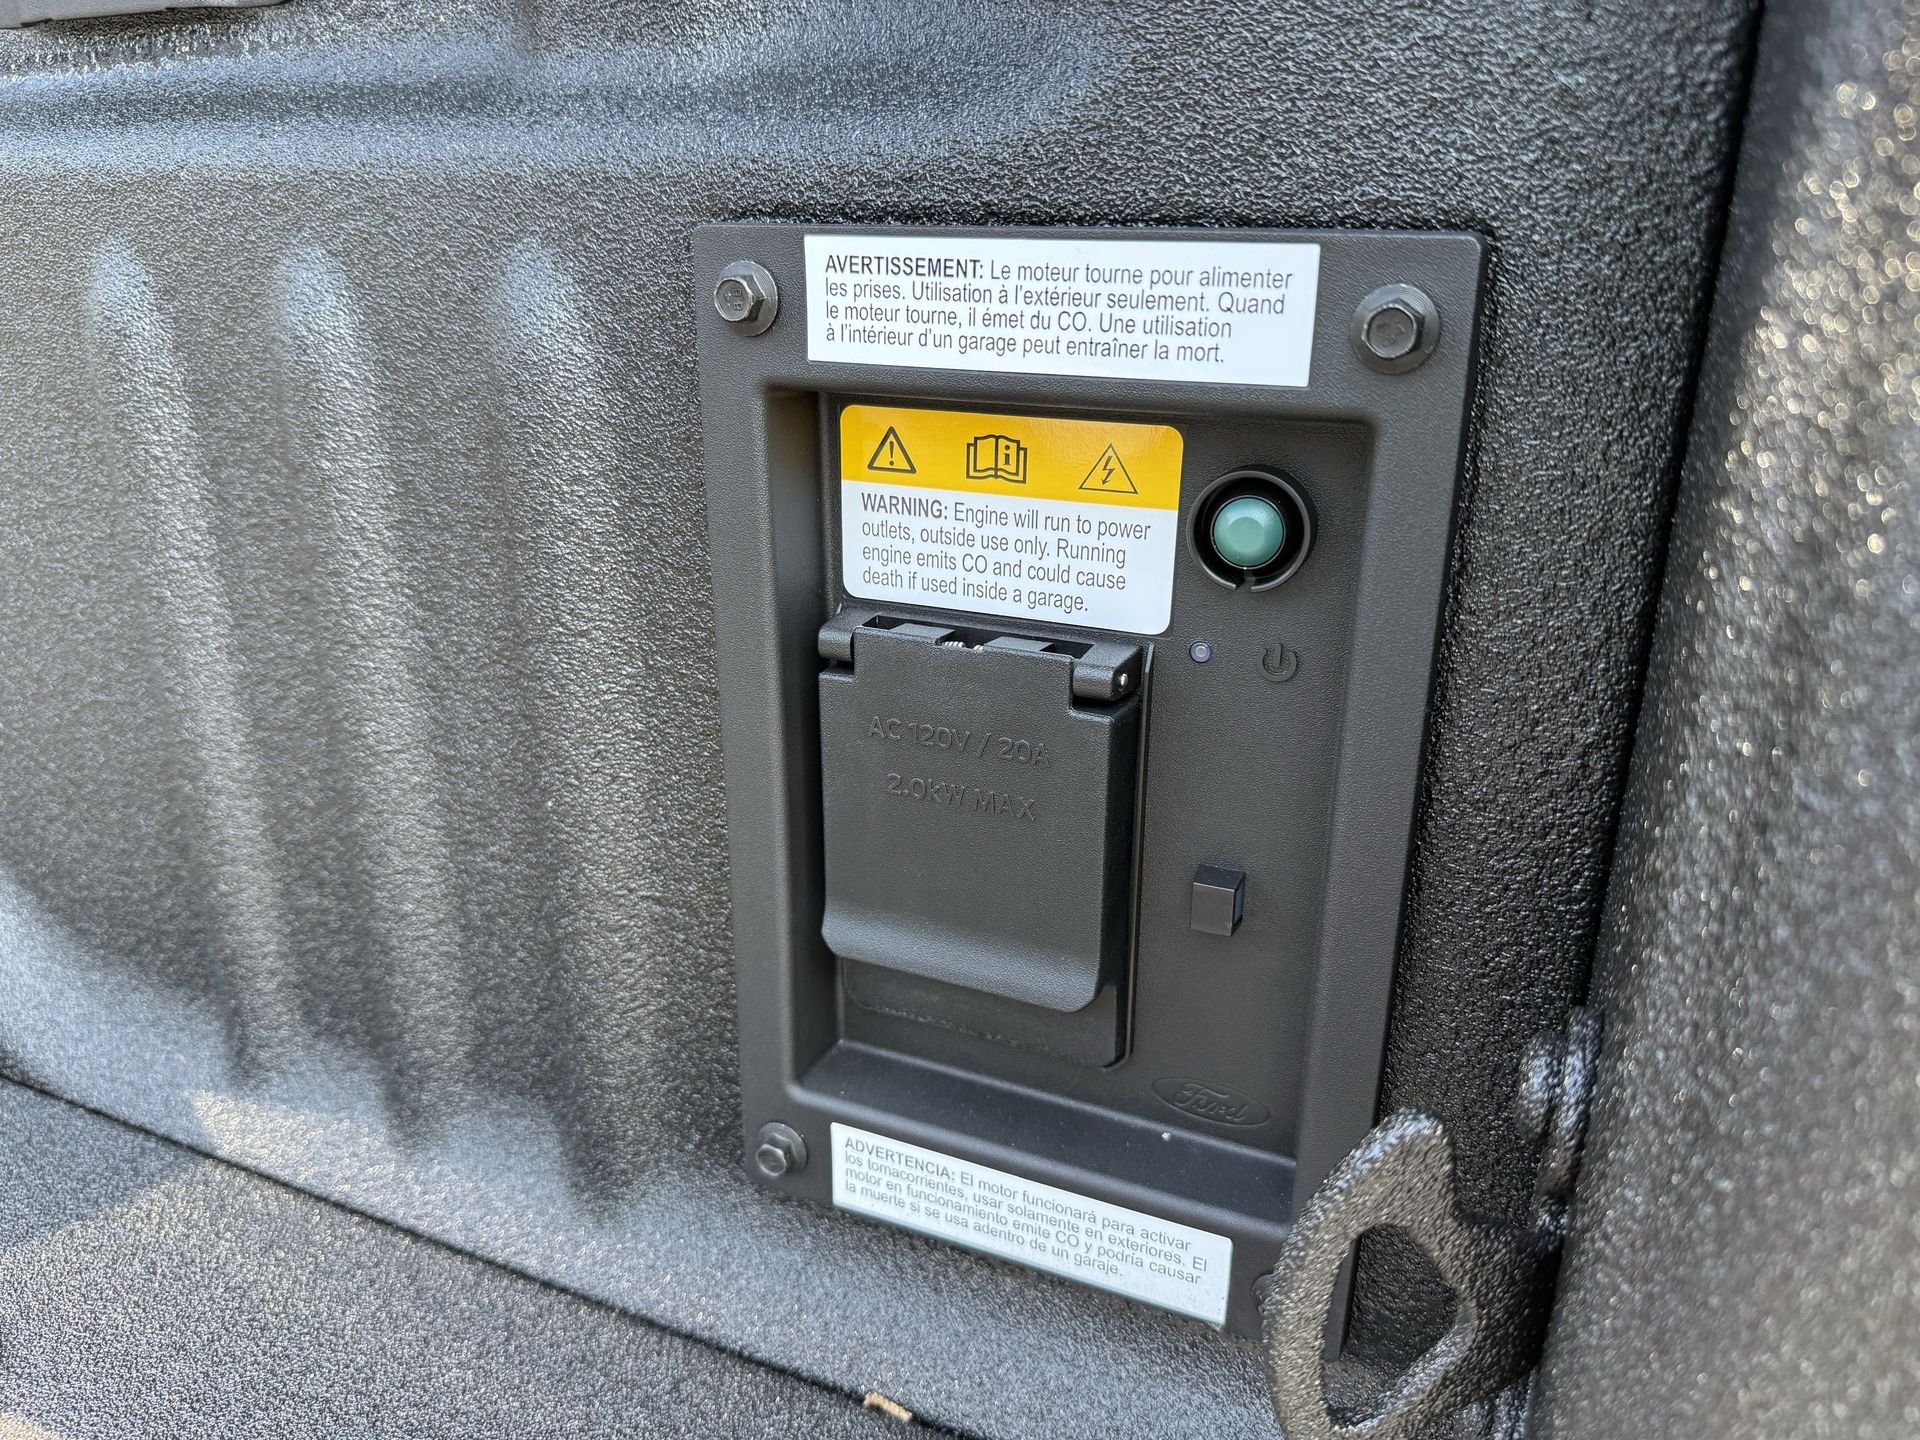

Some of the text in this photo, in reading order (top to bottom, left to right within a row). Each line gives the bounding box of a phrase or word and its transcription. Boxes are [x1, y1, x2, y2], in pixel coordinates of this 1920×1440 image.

[825, 255, 1292, 289] AVERTISSEMENT: Le moteur tourne pour alimenter
[825, 278, 847, 297] les
[854, 280, 905, 302] prises.
[912, 281, 992, 303] Utilisation
[999, 285, 1008, 304] à
[1107, 290, 1209, 312] seulement.
[1218, 292, 1284, 314] Quand
[826, 301, 1231, 337] le moteur tourne, il émet du CO. Une utilisation
[826, 324, 835, 342] à
[959, 336, 1016, 356] garage
[1023, 337, 1060, 357] peut
[1067, 338, 1148, 359] entraîner
[1154, 340, 1169, 360] la
[1177, 344, 1224, 363] mort.
[861, 493, 1151, 540] WARNING: Engine will run to power
[862, 520, 1126, 568] outlets, outside use only. Running
[863, 544, 1126, 589] engine emits CO and could cause
[863, 566, 1088, 615] death if used inside a garage.
[869, 716, 900, 740] AC
[908, 722, 970, 750] 120V
[999, 737, 1050, 767] 20A
[974, 788, 1035, 822] MAX
[1173, 1082, 1248, 1121] Ford
[845, 1137, 1191, 1251] ADVERTENCIA: El motor funcionará para activar
[845, 1151, 863, 1166] los
[973, 1194, 1002, 1209] usar
[1008, 1203, 1079, 1233] solamente
[1085, 1229, 1102, 1240] en
[1193, 1257, 1207, 1272] El
[846, 1179, 856, 1192] la
[861, 1187, 905, 1207] muerte
[910, 1201, 920, 1213] si
[925, 1207, 940, 1218] se
[945, 1214, 968, 1227] usa
[973, 1222, 1024, 1246] adentro
[1030, 1238, 1046, 1251] de
[1052, 1245, 1068, 1259] un
[846, 1167, 1201, 1285] motor en funcionamiento emite CO y podría causar
